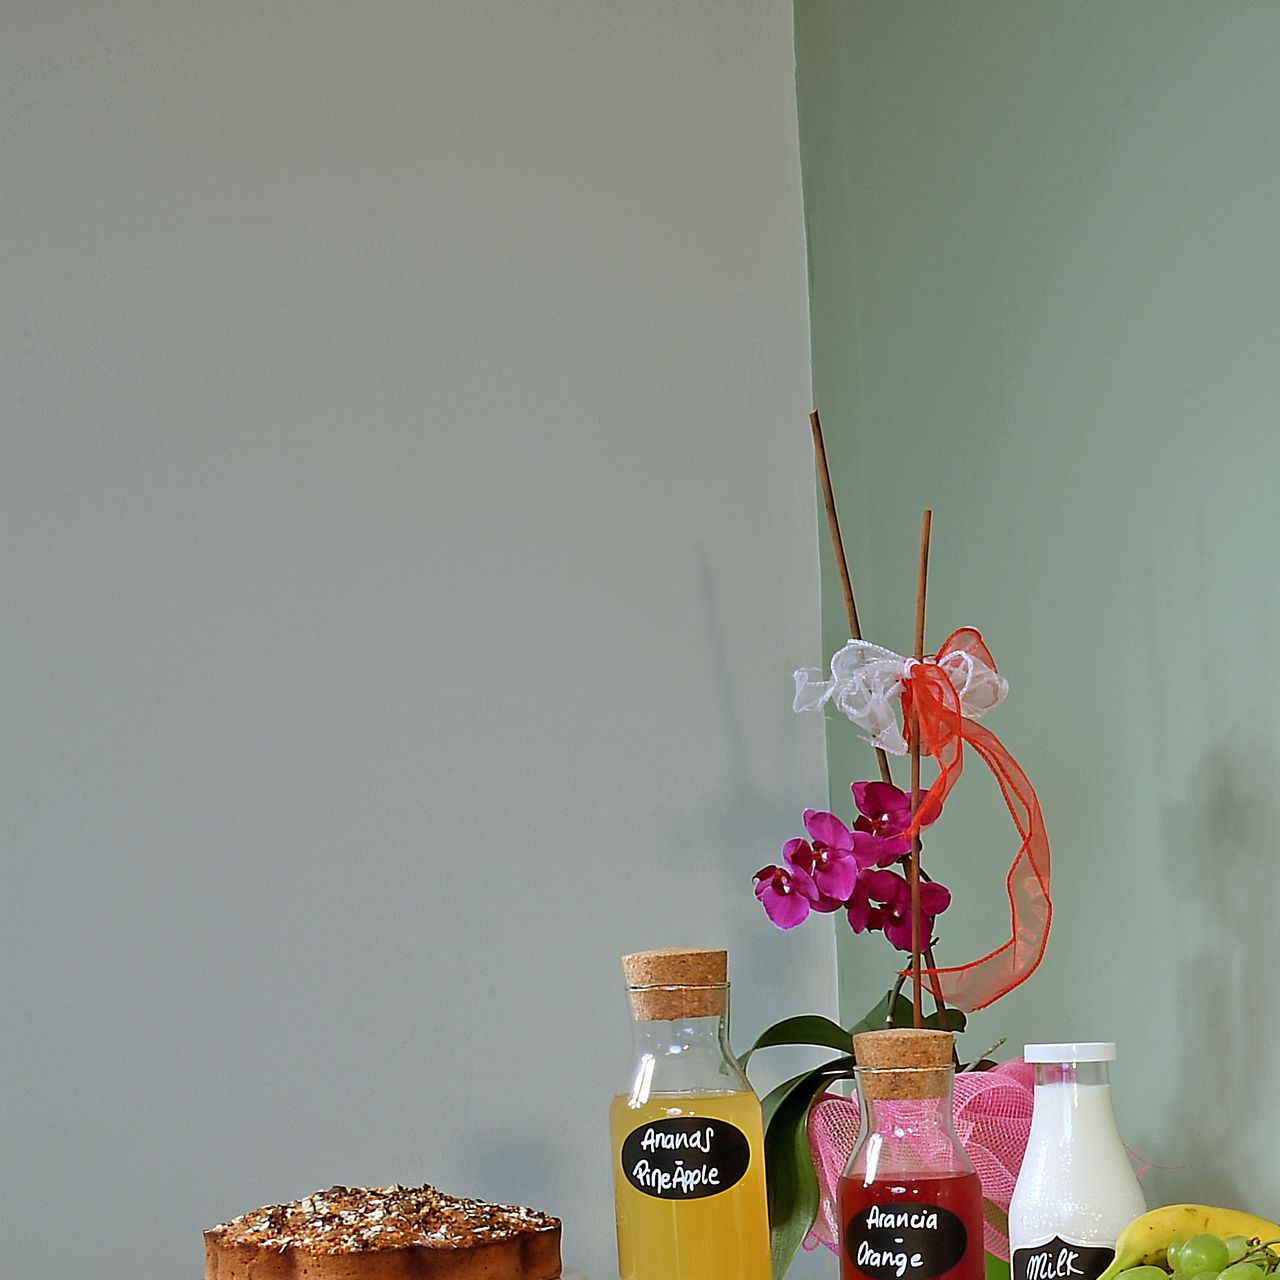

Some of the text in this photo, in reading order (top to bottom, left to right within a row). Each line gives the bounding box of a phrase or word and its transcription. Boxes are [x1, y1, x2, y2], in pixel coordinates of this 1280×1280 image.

[640, 1127, 714, 1153] Ananas
[866, 1205, 938, 1230] Arancia
[857, 1240, 924, 1277] Orange
[1026, 1248, 1085, 1280] Milk
